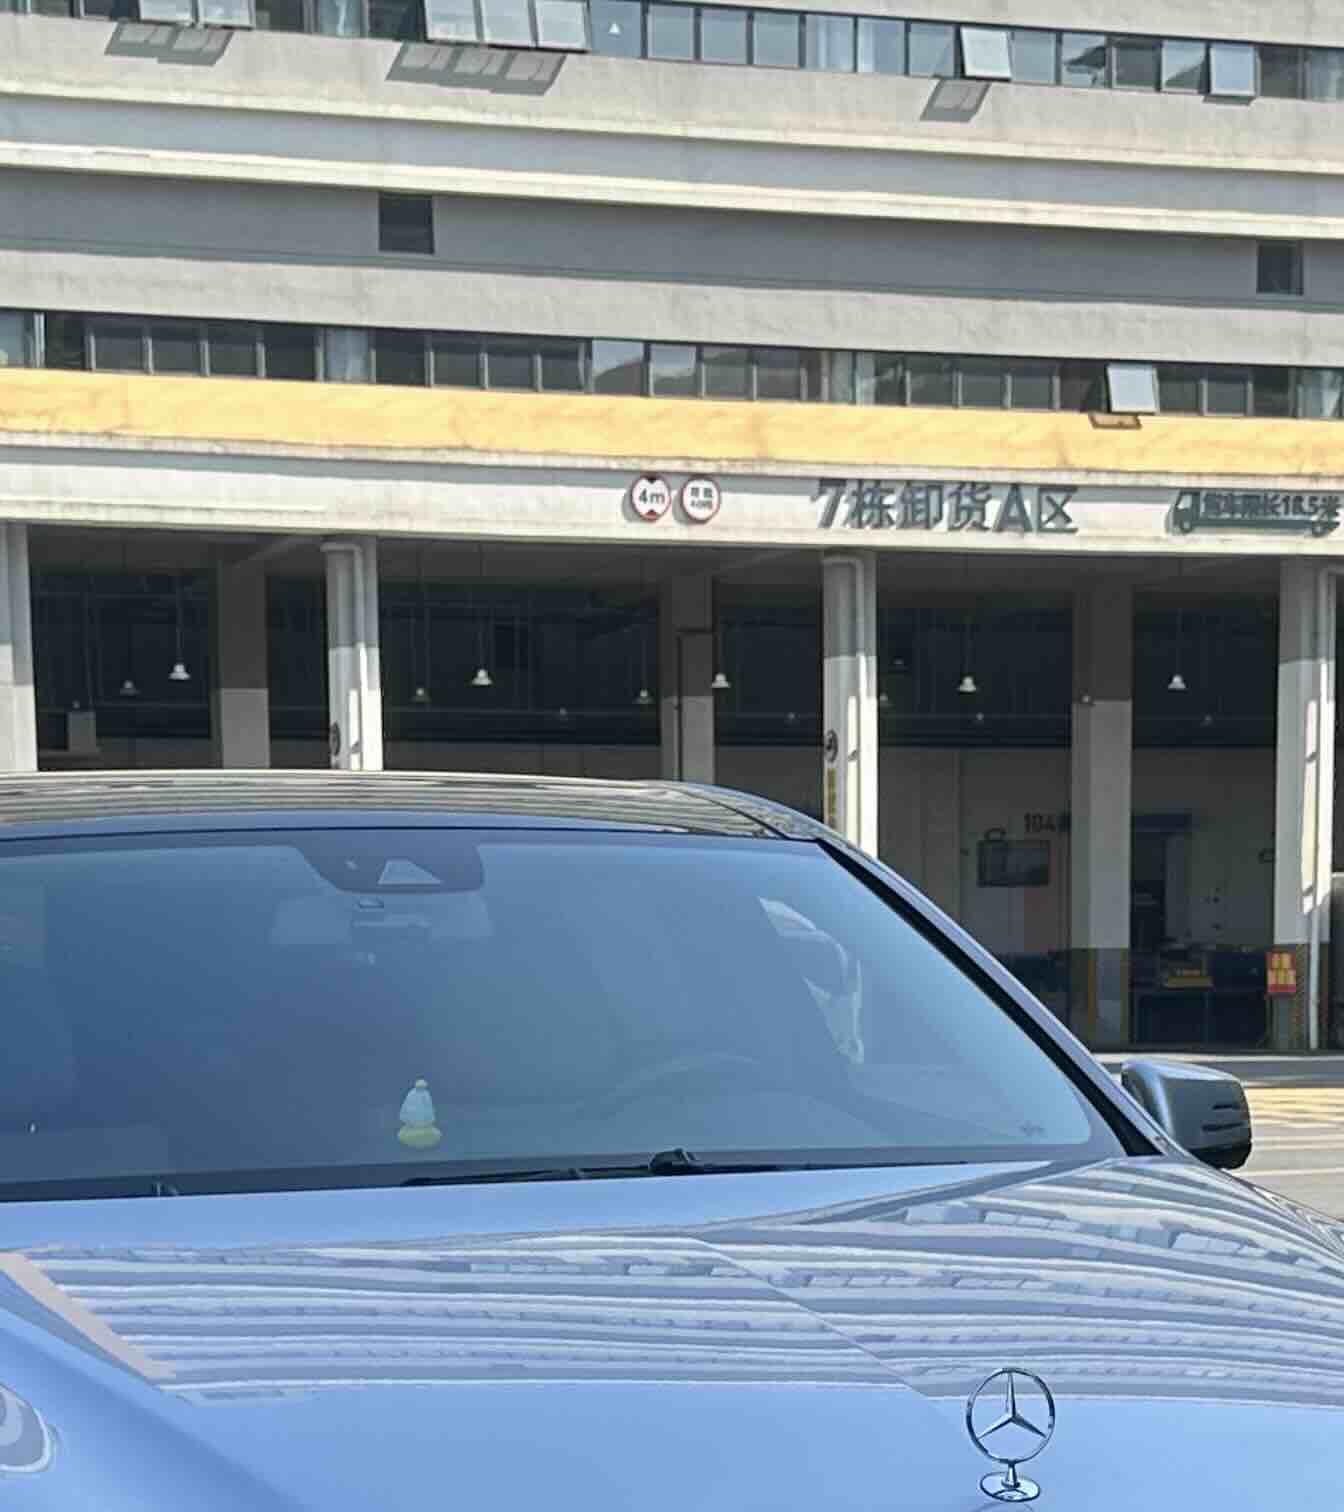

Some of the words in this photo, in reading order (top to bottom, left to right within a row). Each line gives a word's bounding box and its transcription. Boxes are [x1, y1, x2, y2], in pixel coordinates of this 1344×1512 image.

[639, 487, 665, 504] 4m
[816, 477, 1080, 534] 7栋卸货A区
